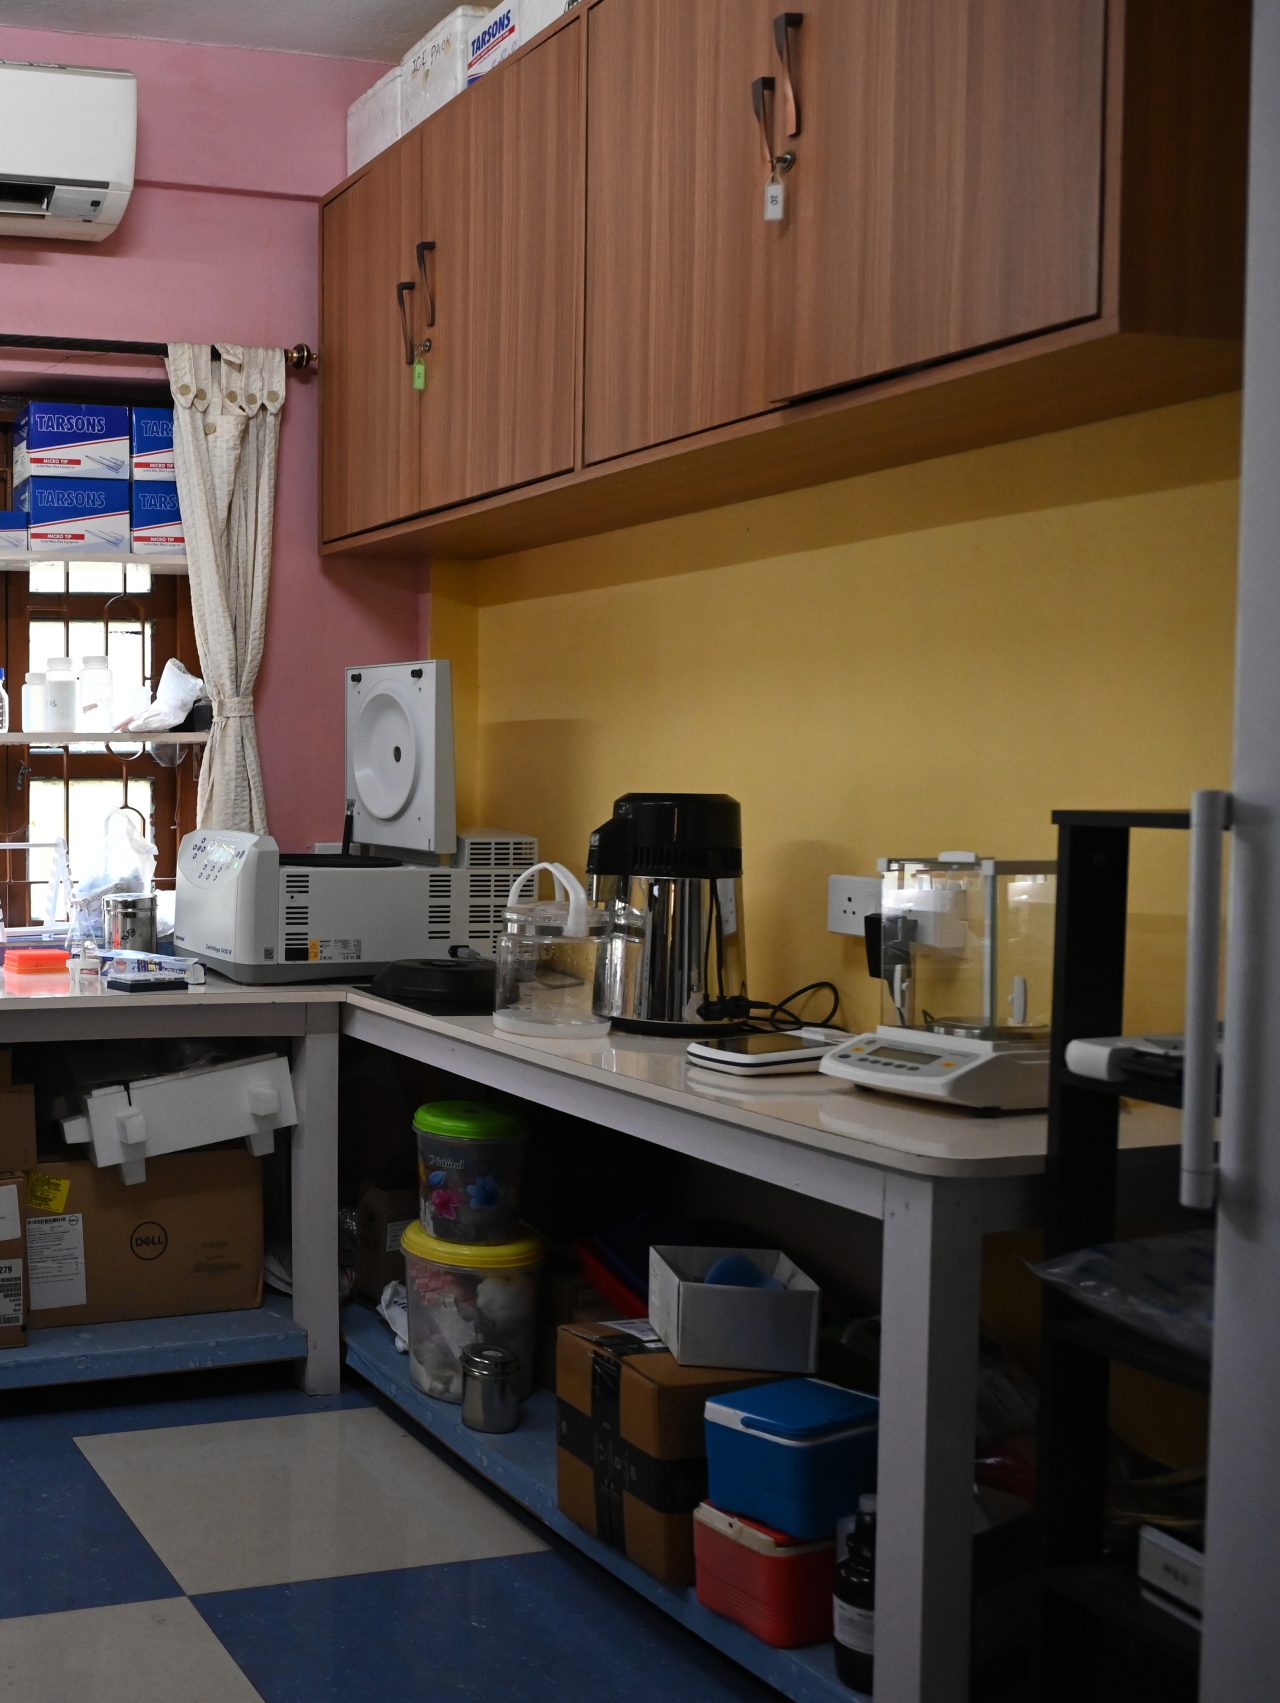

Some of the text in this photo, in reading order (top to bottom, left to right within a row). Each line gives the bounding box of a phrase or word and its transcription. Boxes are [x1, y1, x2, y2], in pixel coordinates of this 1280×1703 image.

[471, 9, 512, 57] TARSONS
[35, 414, 106, 434] TARSONS
[35, 489, 106, 508] TARSONS
[138, 493, 180, 511] TARS
[135, 1235, 164, 1247] DELL
